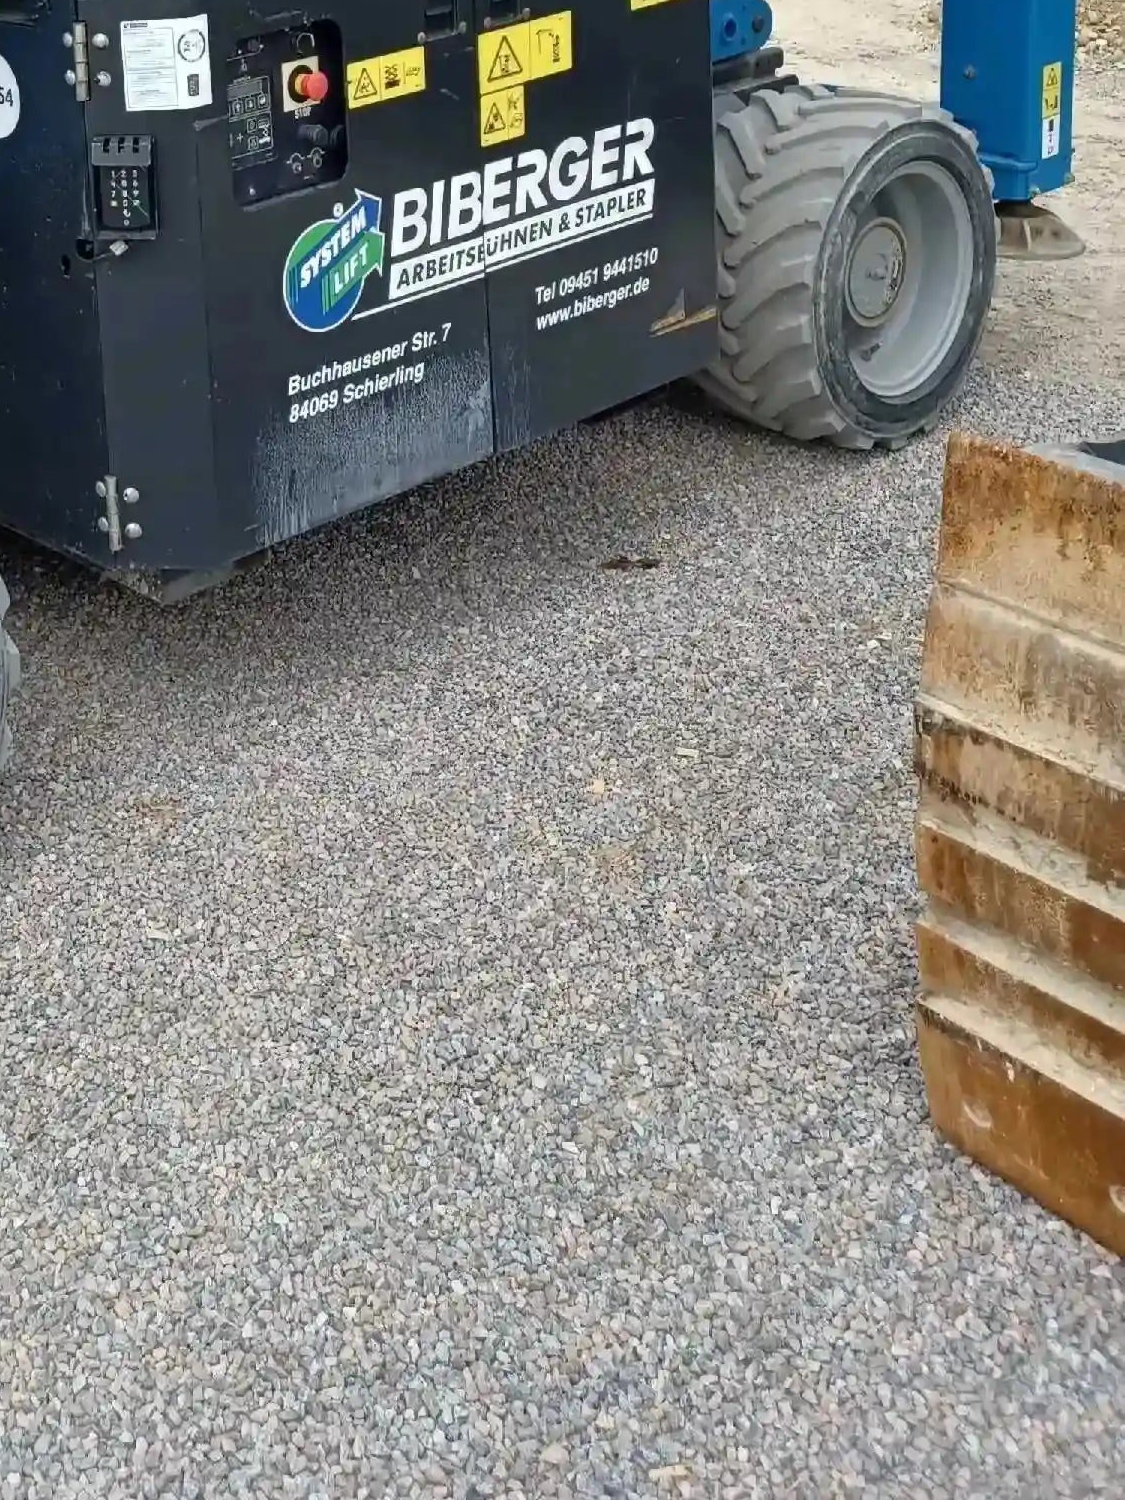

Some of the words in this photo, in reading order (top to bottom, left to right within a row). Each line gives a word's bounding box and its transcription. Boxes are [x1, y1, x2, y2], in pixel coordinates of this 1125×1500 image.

[389, 117, 655, 258] BIBERGER
[300, 205, 367, 288] SYSTEM
[334, 241, 369, 295] LIFT
[396, 216, 553, 290] ARBEITSBÜHNEN
[557, 212, 571, 232] &
[574, 187, 647, 228] STAPLER
[535, 281, 556, 305] Tel
[559, 266, 599, 297] 09451
[602, 247, 659, 281] 9441510
[536, 275, 650, 331] www.biberger.de
[288, 340, 409, 396] Buchhausener
[411, 330, 438, 352] Str.
[441, 322, 452, 342] 7
[288, 388, 340, 424] 84069
[342, 361, 426, 403] Schierling
